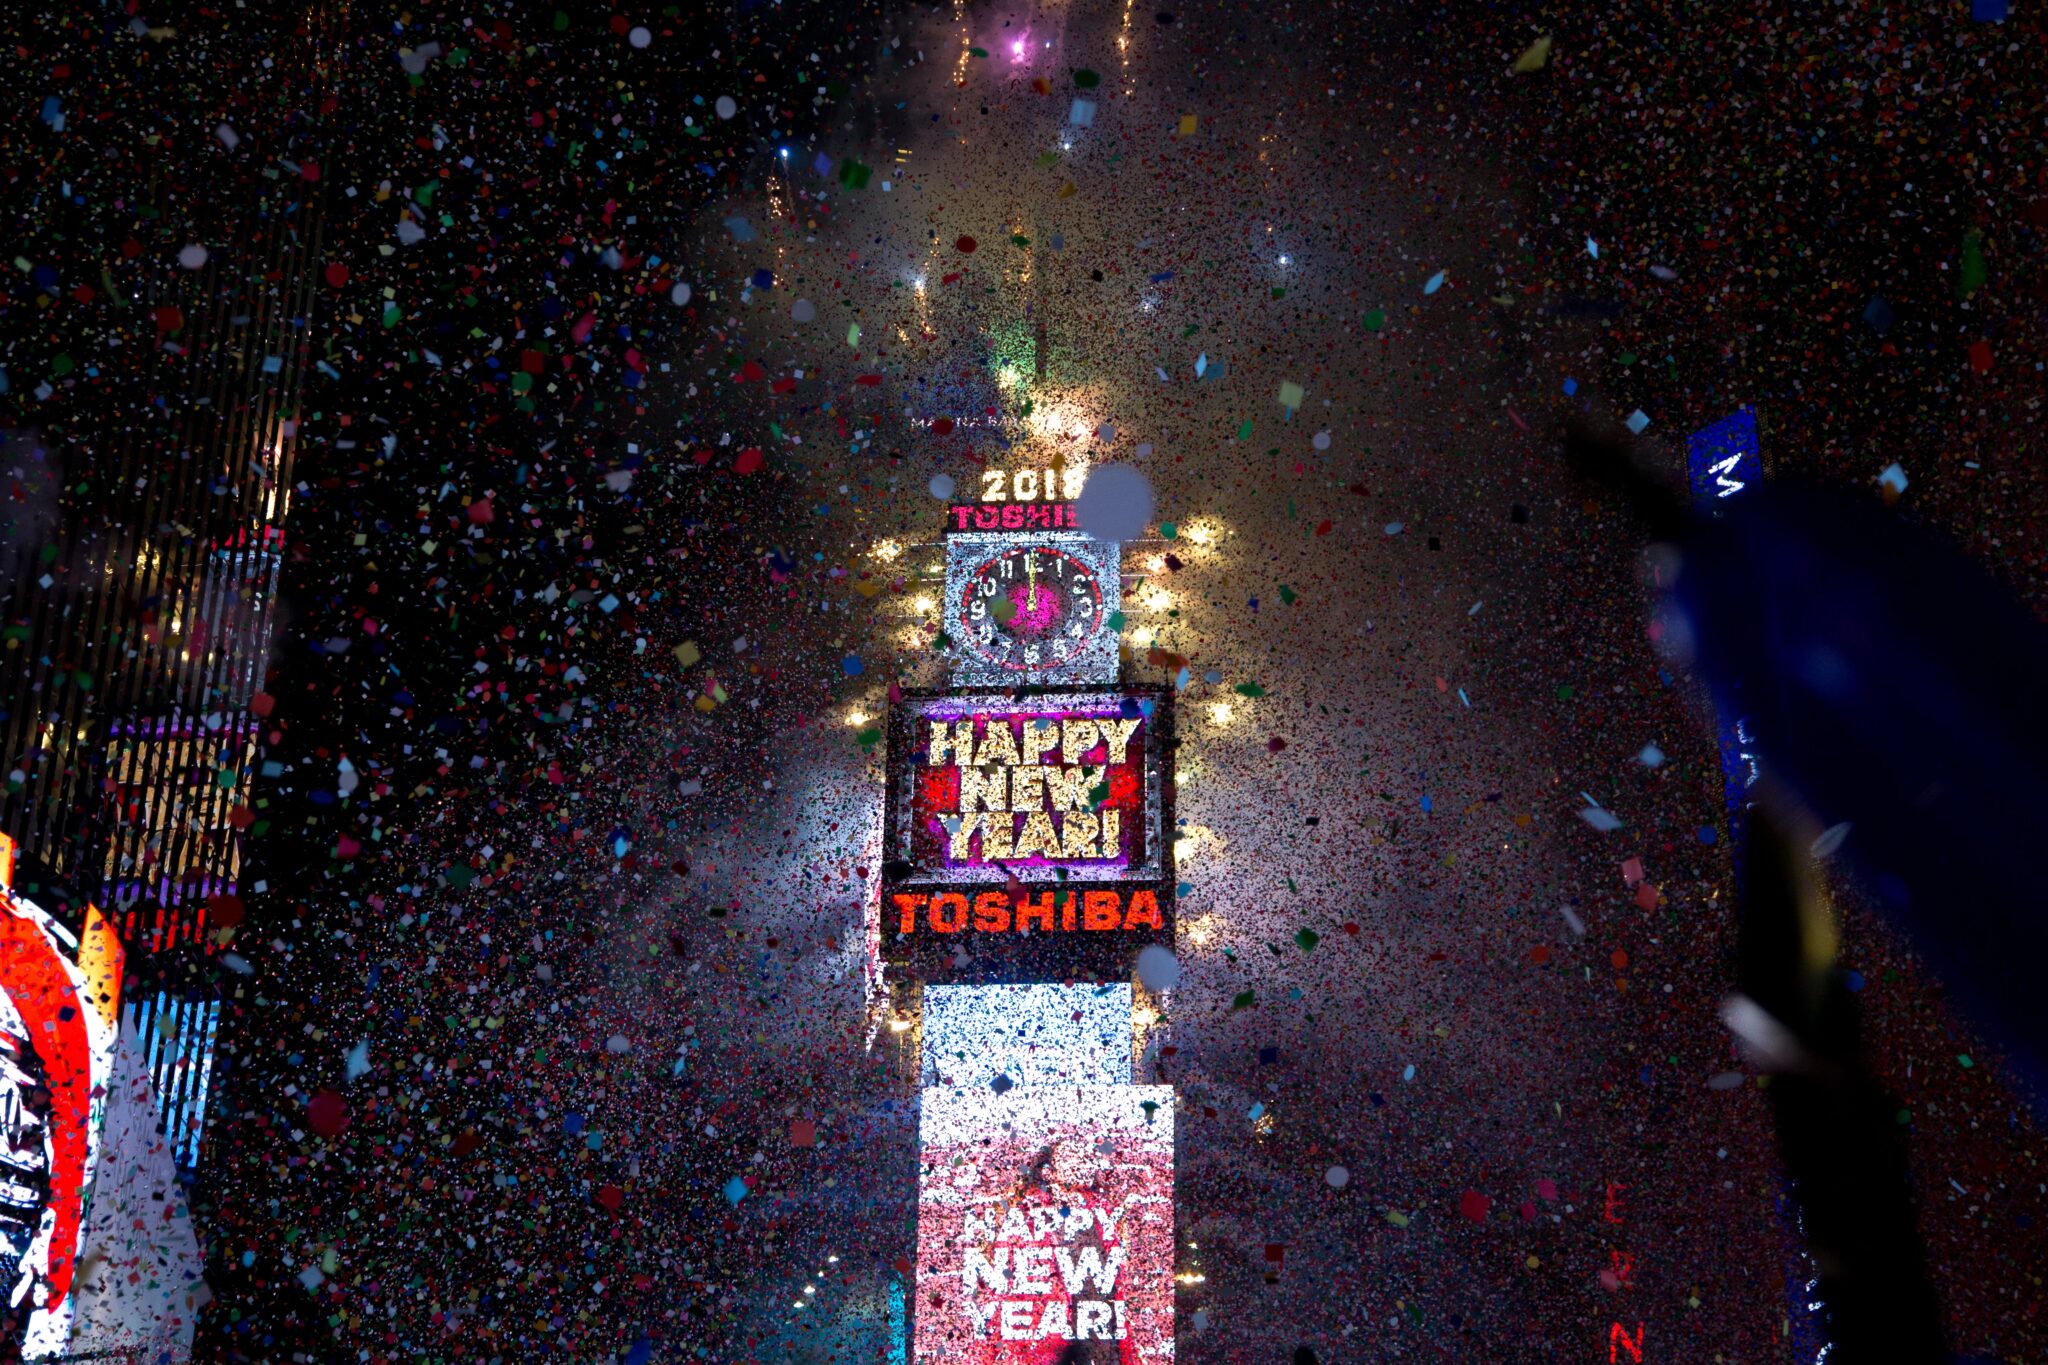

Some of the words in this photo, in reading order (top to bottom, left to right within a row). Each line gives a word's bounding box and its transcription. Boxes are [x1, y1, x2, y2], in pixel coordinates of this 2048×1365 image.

[982, 470, 1087, 501] 2018
[951, 504, 1083, 530] TOSHI
[971, 600, 986, 620] 9
[929, 717, 1142, 766] HAPPY
[959, 764, 1106, 812] NEW
[938, 809, 1120, 861] YEAR!
[891, 889, 1164, 934] TOSHIBA
[963, 1206, 1125, 1242] HAPPY
[962, 1246, 1125, 1295] NEW
[962, 1300, 1128, 1341] YEAR!
